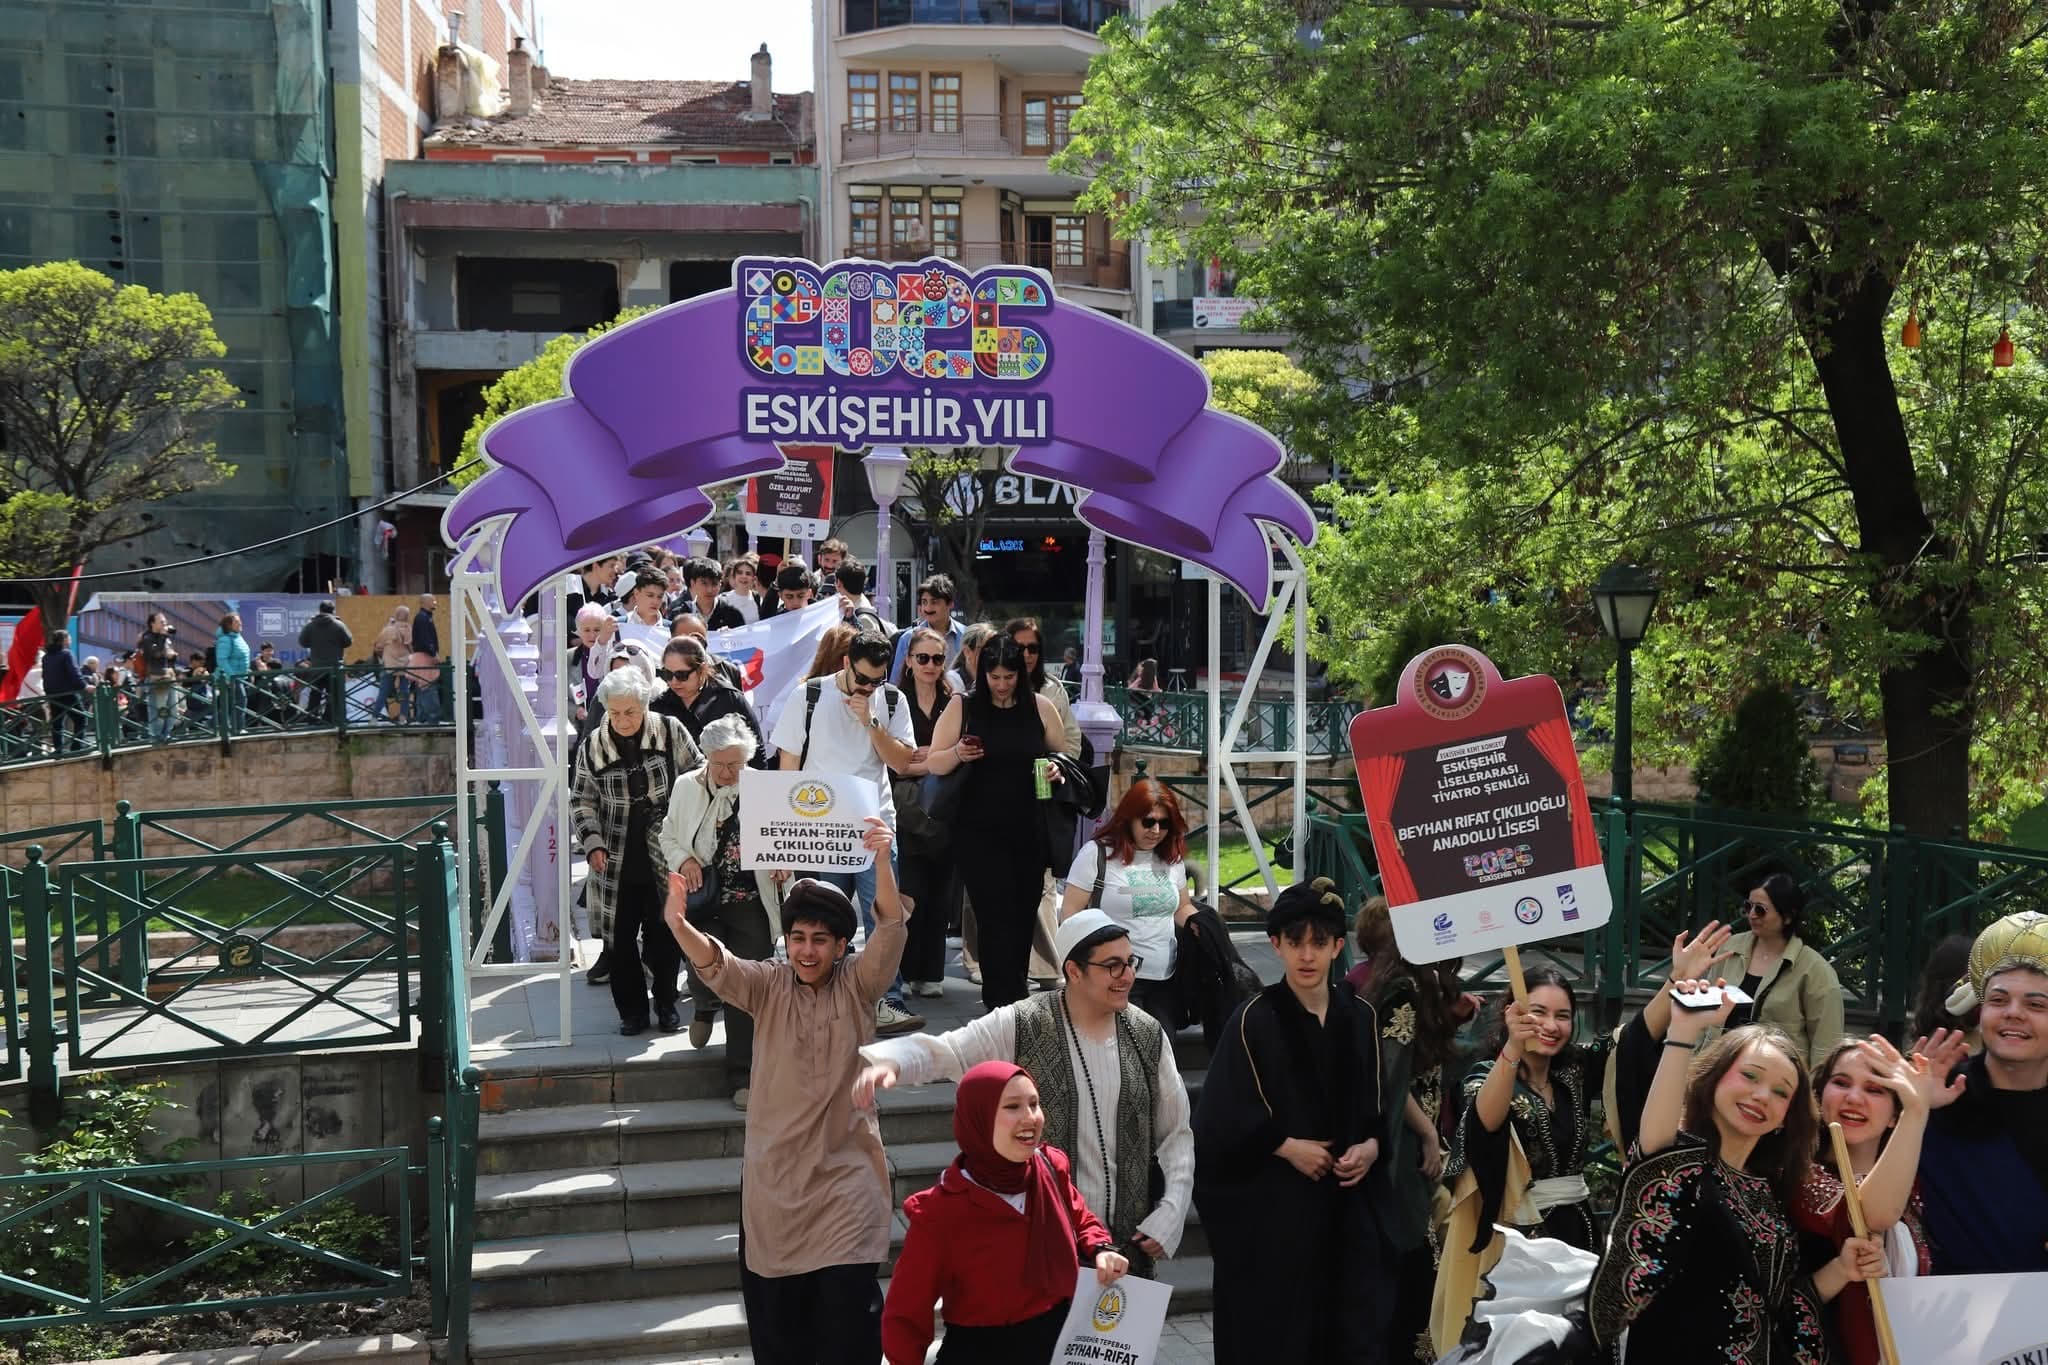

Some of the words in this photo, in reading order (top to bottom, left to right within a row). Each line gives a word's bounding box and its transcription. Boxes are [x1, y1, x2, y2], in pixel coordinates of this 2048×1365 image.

[747, 385, 963, 442] ESKİŞEHİR
[972, 399, 1047, 438] YILI
[1442, 751, 1507, 774] ESKİŞEHİR
[1432, 786, 1481, 803] TİYATRO
[1484, 773, 1530, 795] ŞENLİĞİ
[1437, 764, 1519, 789] LİSELERARASI
[1398, 818, 1452, 841] BEYHAN
[1455, 810, 1490, 829] RIFAT
[1493, 795, 1566, 823] ÇIKILIOĞLU
[760, 827, 865, 840] BEYHAN-RIFAT
[1432, 827, 1496, 852] ANADOLU
[1499, 816, 1540, 838] LİSESİ
[773, 840, 853, 853] ÇIKILIOĞLU
[755, 853, 825, 864] ANADOLU
[828, 854, 868, 866] LİSESİ
